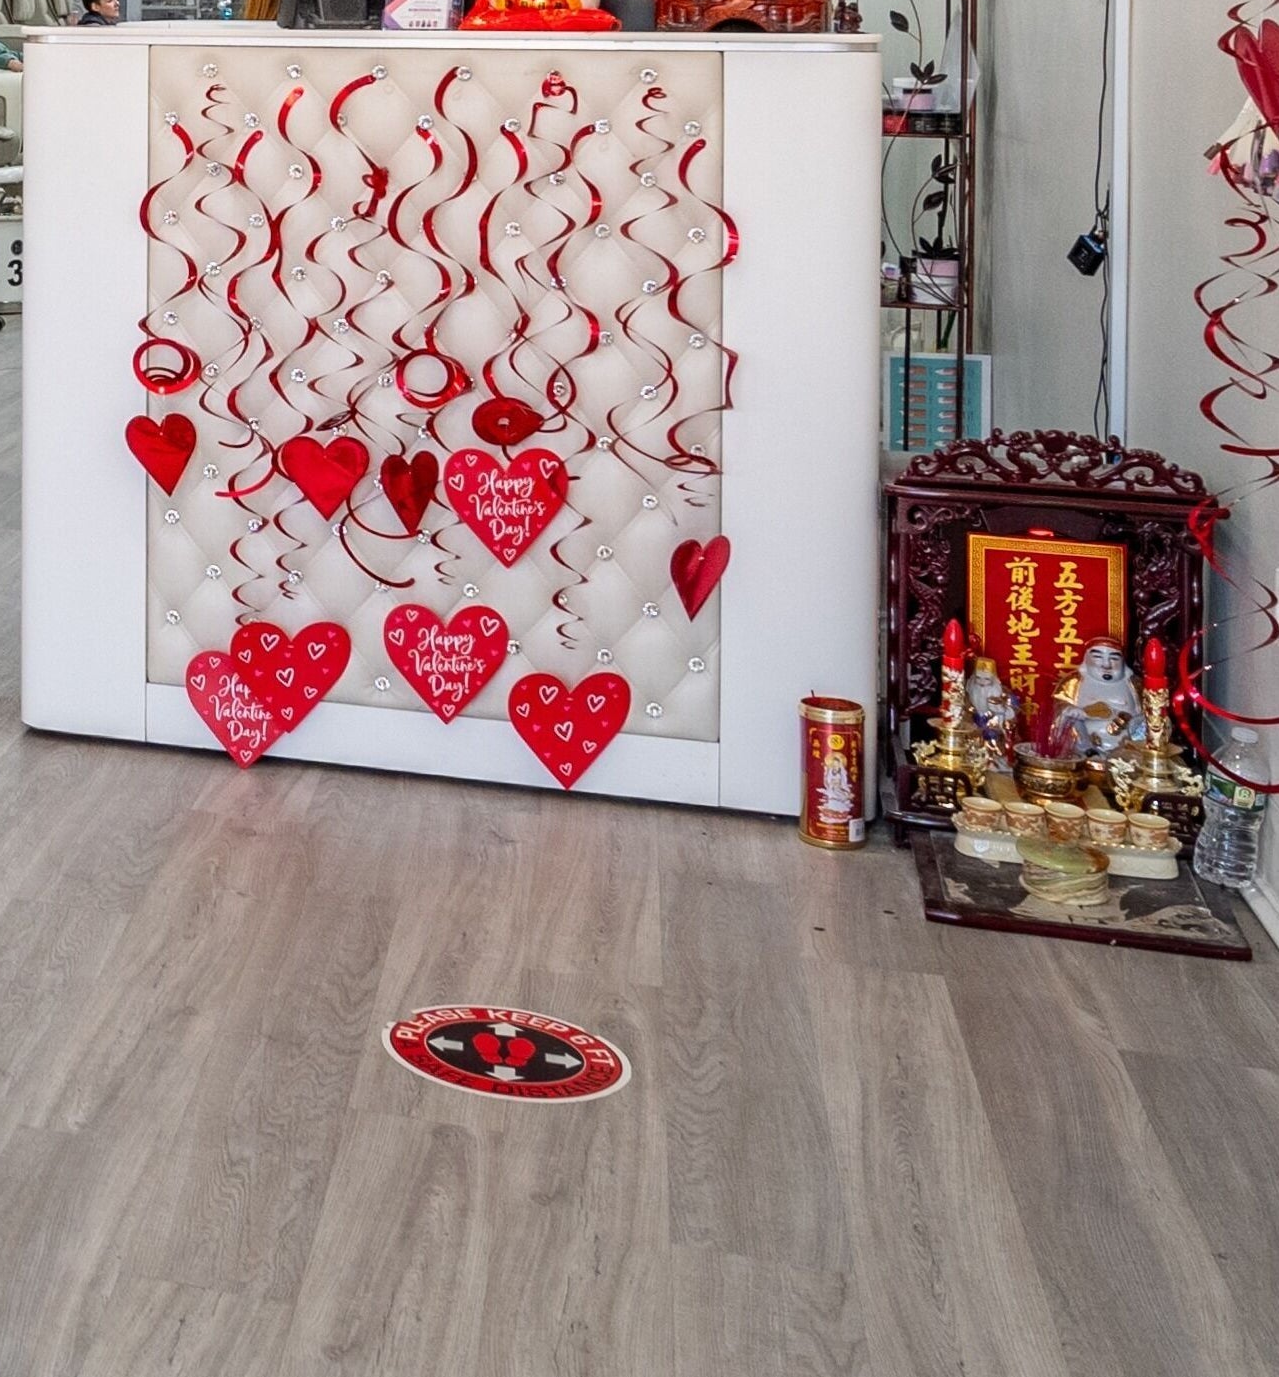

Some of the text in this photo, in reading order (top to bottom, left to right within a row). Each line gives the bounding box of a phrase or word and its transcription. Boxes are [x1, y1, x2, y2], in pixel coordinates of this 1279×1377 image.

[7, 259, 22, 287] 3
[477, 469, 534, 497] Happy
[468, 494, 546, 521] Valentine's
[489, 516, 530, 545] Day!
[417, 625, 476, 655] Happy
[408, 649, 486, 676] Valentine's
[218, 673, 252, 699] Hap
[428, 672, 470, 702] Day!
[209, 694, 273, 721] Valentine
[227, 719, 268, 748] Day!
[396, 1008, 616, 1068] PLEASE KEEP 6 FT
